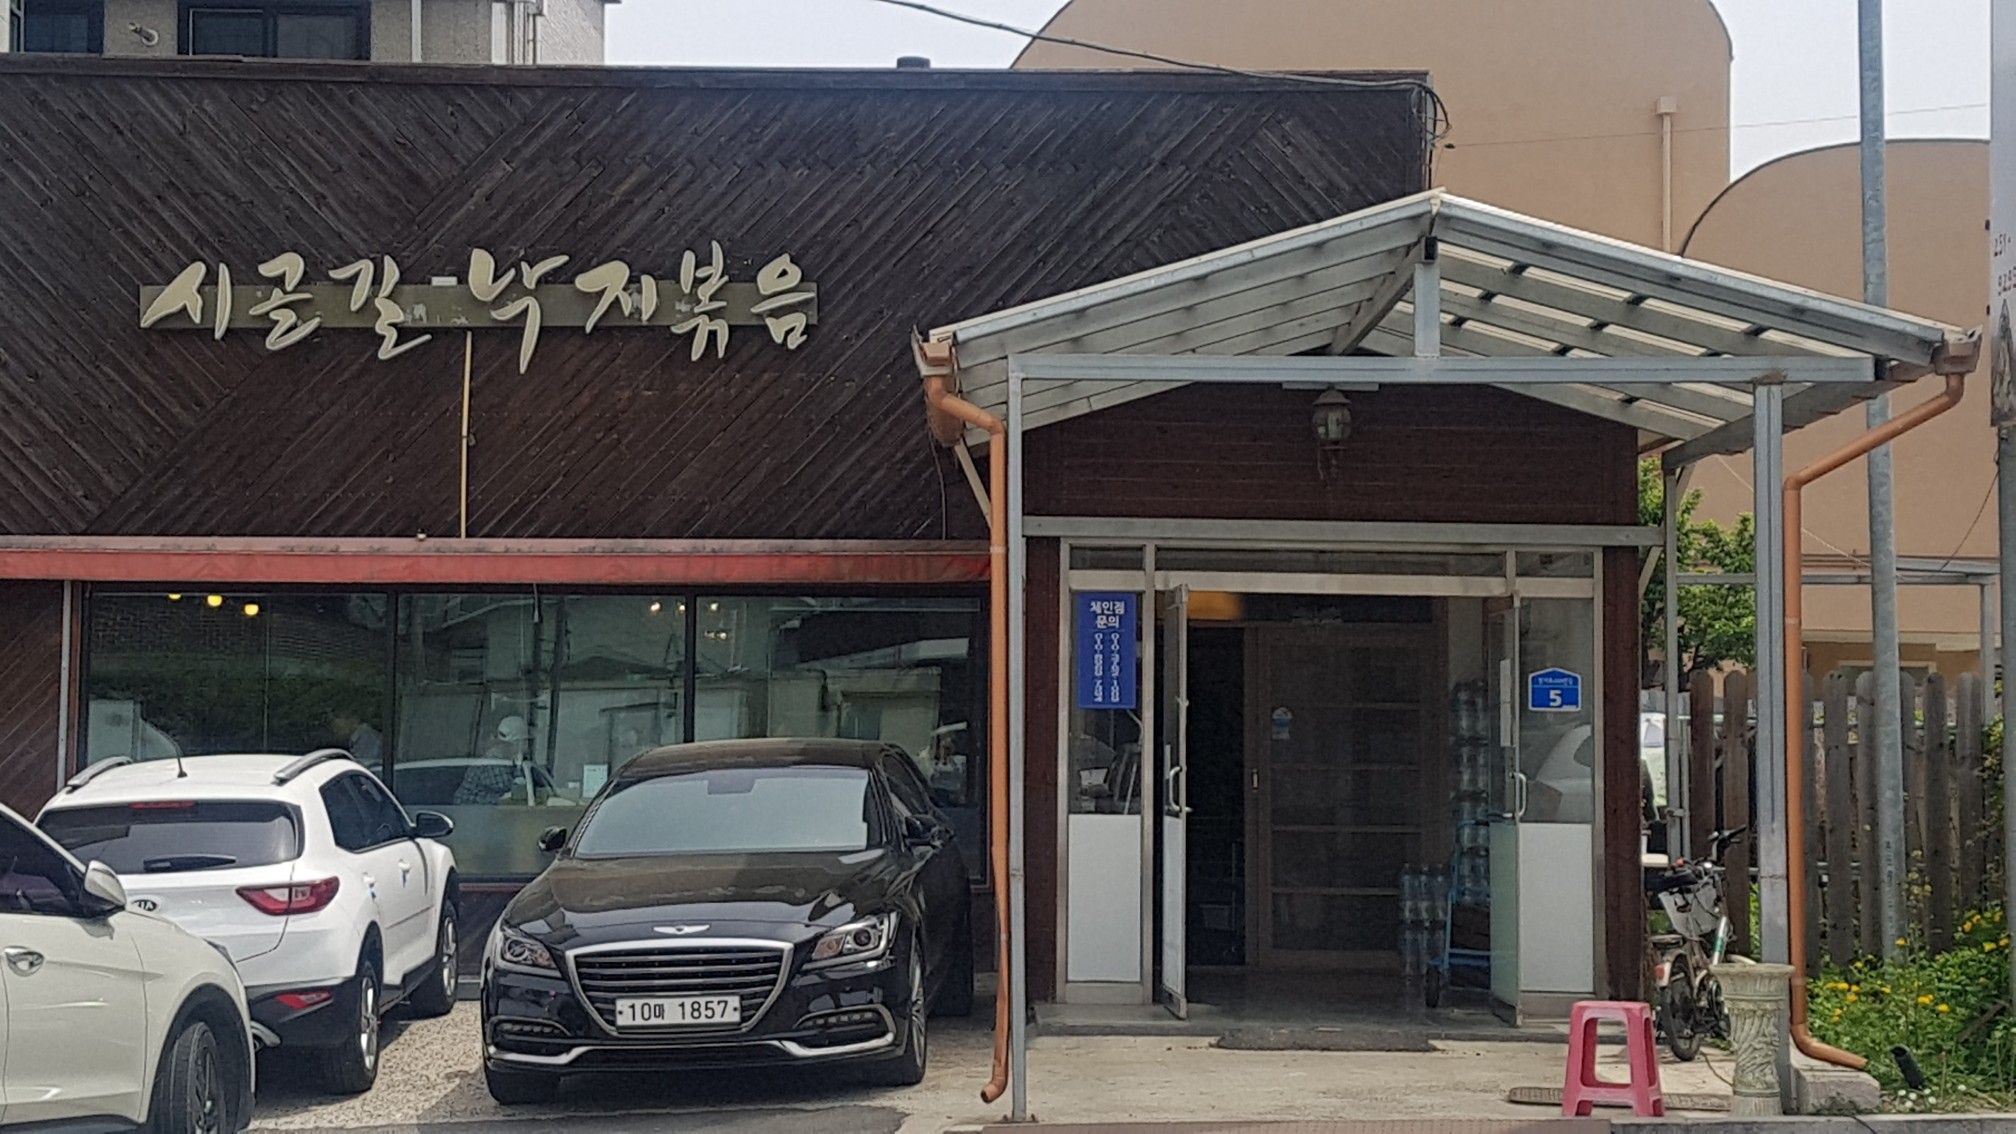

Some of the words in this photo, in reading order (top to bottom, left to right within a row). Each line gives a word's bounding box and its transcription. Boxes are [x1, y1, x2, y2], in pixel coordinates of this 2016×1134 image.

[141, 250, 431, 361] 시골길
[467, 240, 816, 374] 낙지볶음
[1089, 600, 1125, 615] 체인점
[1096, 615, 1120, 629] 문의
[1549, 689, 1562, 707] 5
[628, 1002, 665, 1021] 10마
[678, 1000, 729, 1020] 1857
